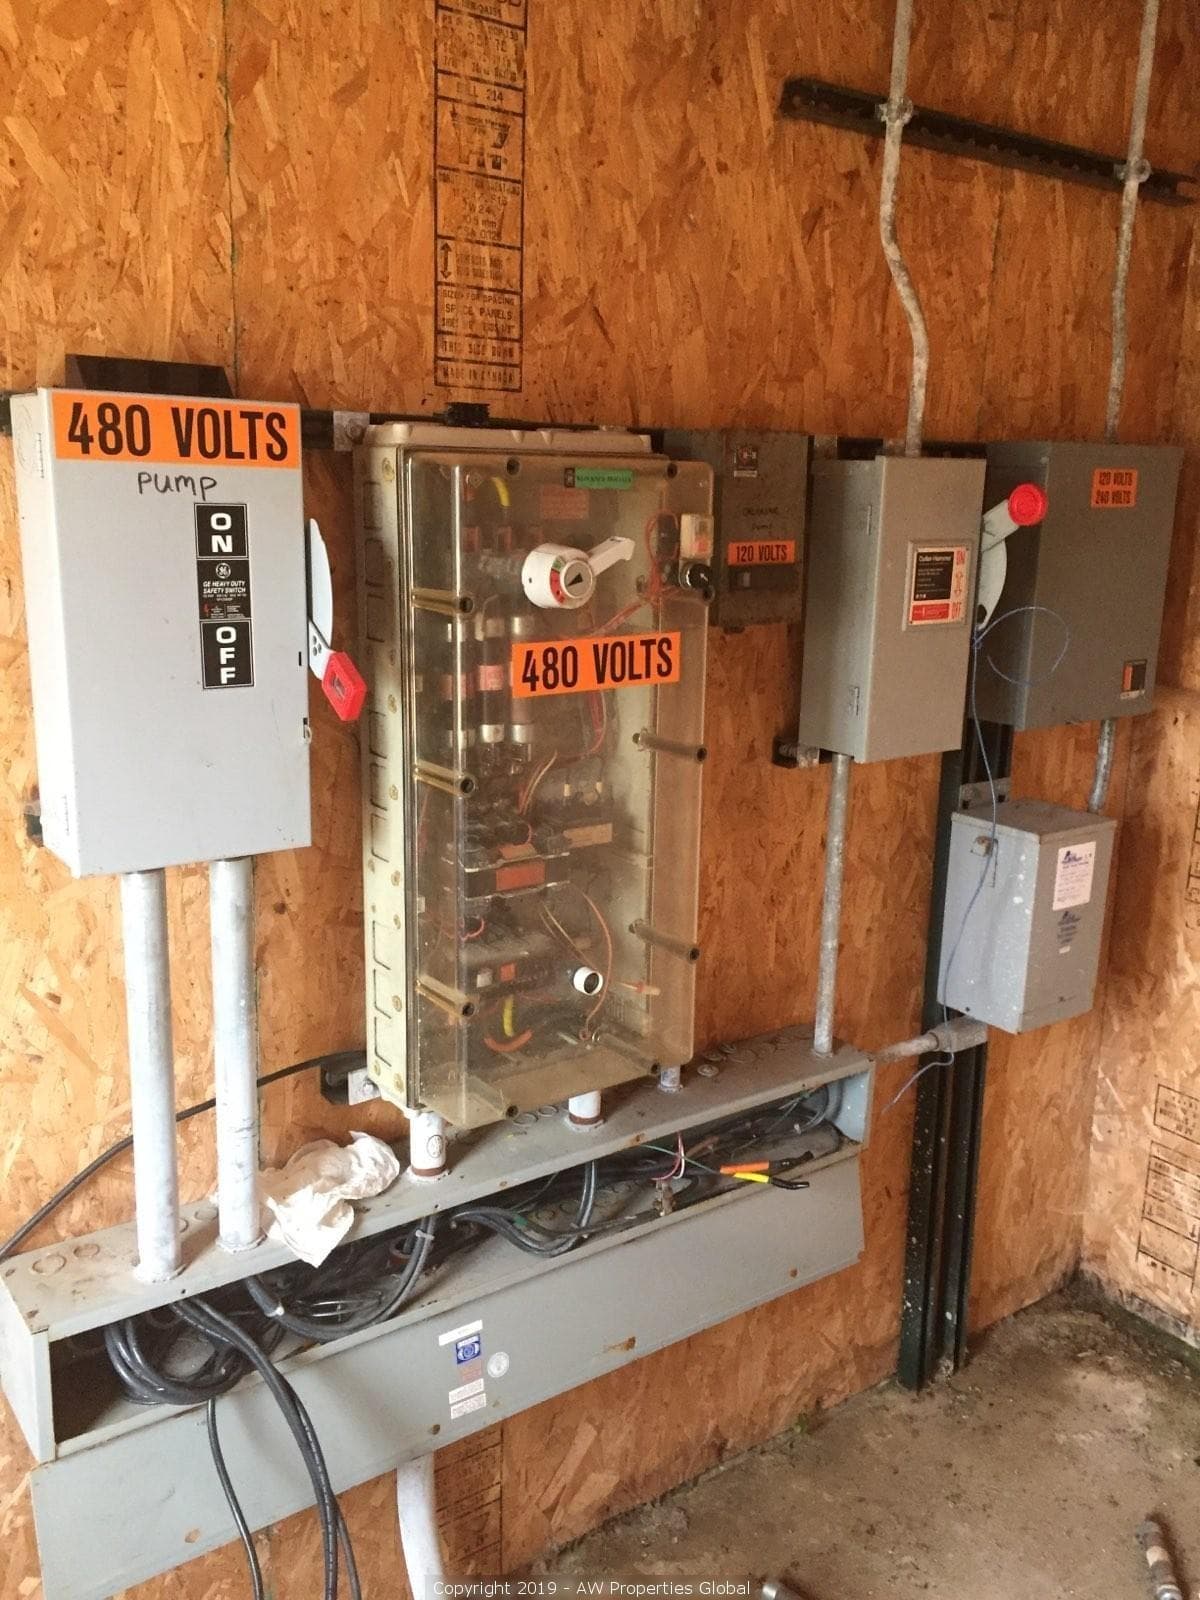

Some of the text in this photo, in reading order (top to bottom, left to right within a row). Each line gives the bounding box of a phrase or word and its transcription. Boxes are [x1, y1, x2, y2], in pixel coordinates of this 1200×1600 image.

[68, 402, 288, 461] 480 VOLTS
[210, 512, 233, 553] ON
[736, 543, 788, 562] 120 VOLTS
[202, 580, 211, 588] GE
[215, 626, 237, 684] OFF
[521, 637, 673, 692] 480 VOLTS
